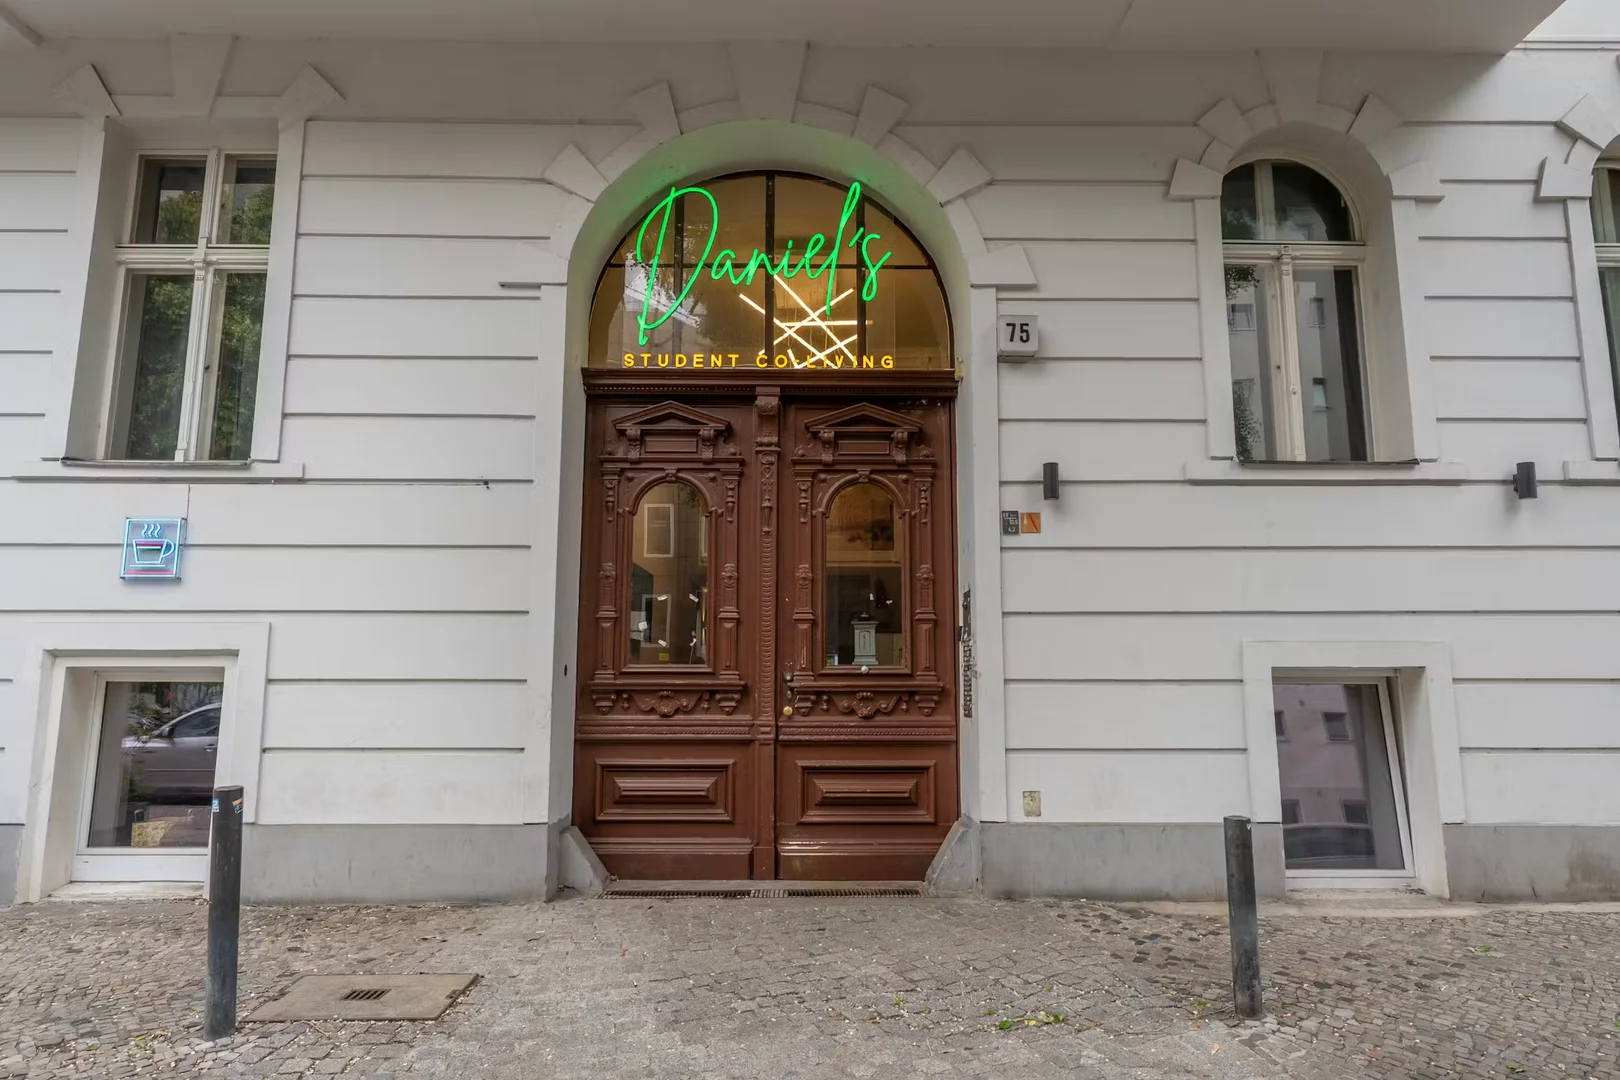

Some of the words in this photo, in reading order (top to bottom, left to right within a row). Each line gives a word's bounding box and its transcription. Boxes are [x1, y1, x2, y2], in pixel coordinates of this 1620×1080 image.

[636, 181, 892, 347] Daniel's
[1005, 322, 1030, 343] 75
[623, 354, 740, 369] STUDENT
[755, 354, 894, 369] CO-LIVING
